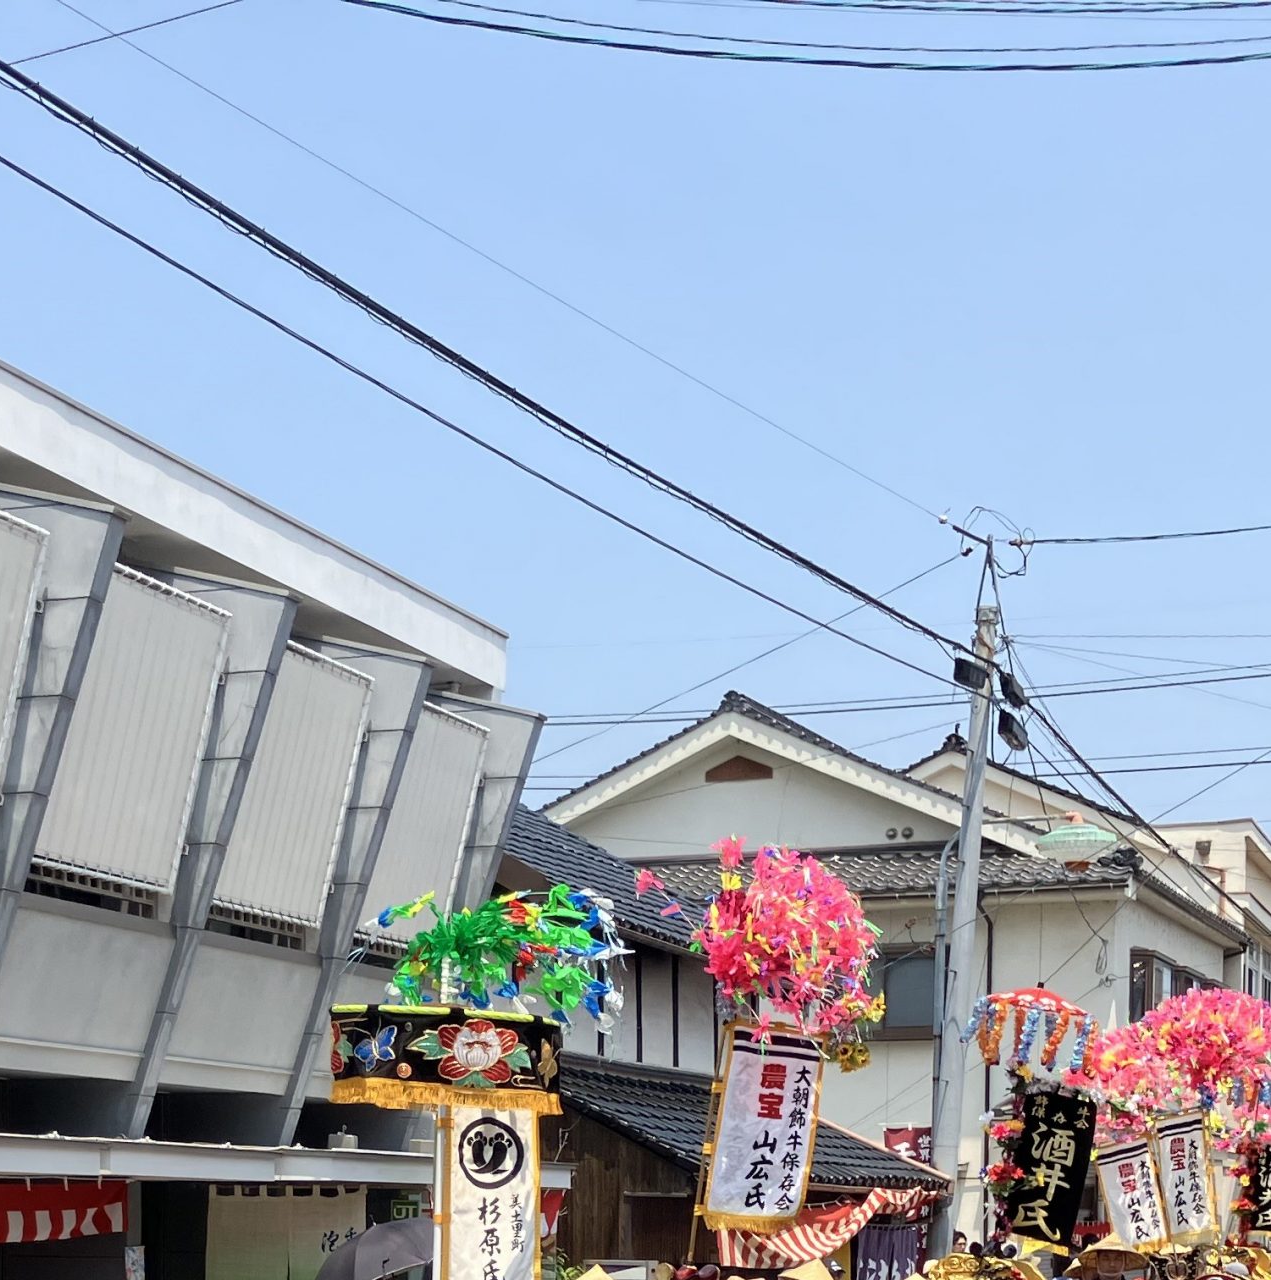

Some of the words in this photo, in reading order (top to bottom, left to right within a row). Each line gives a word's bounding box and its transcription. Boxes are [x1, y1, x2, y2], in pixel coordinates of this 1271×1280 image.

[757, 1063, 788, 1121] 農宝
[744, 1130, 777, 1210] 山広氏
[774, 1065, 812, 1210] 大朝飾牛保存会
[1012, 1121, 1077, 1241] 酒井氏
[508, 1193, 526, 1253] 美土里町
